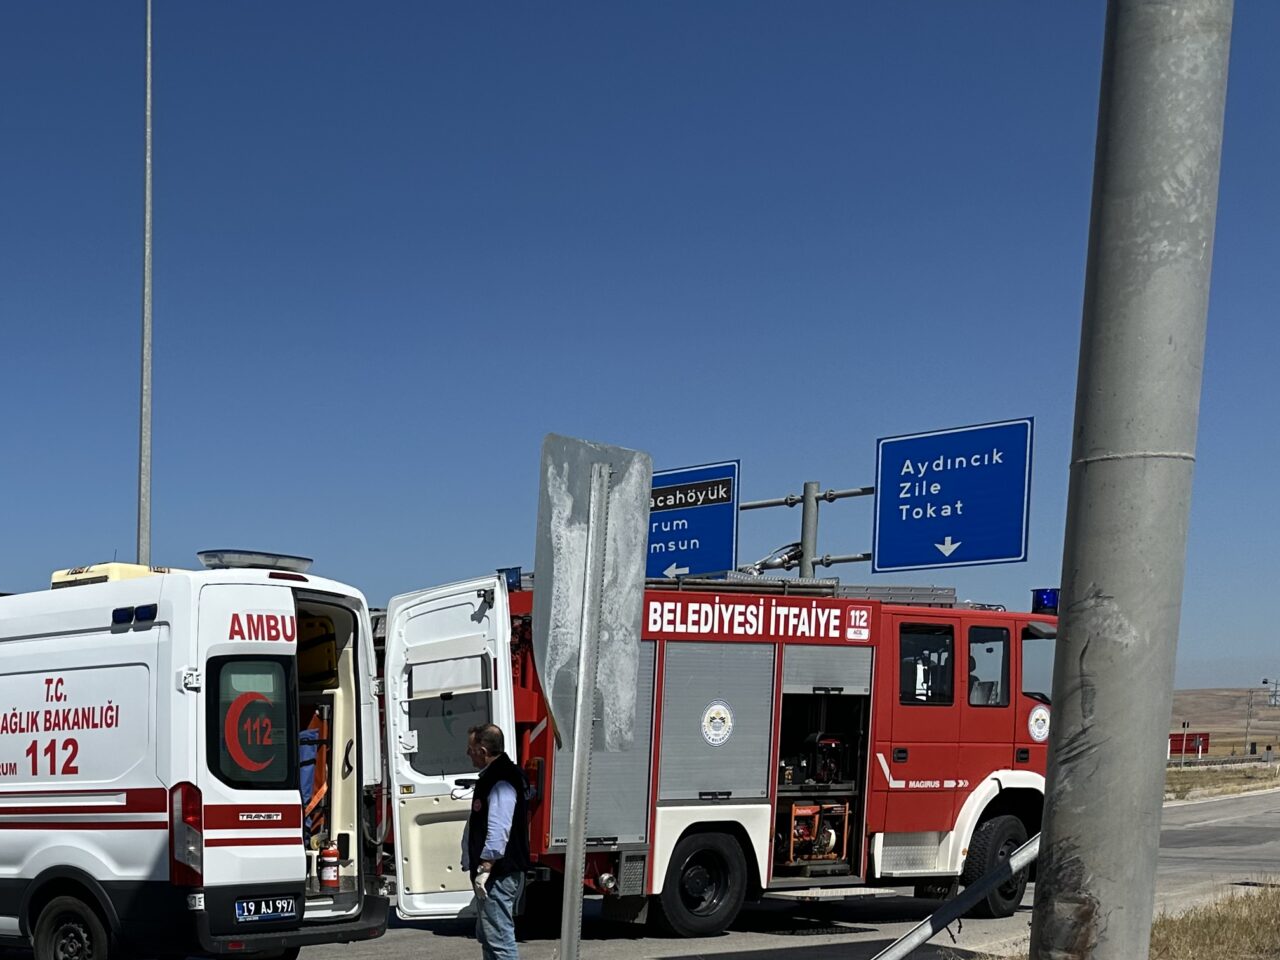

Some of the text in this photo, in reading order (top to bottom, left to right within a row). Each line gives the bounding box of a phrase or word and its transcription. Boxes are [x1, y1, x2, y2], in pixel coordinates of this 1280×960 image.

[900, 447, 1004, 478] Aydıncık
[649, 484, 728, 508] acahöyük
[899, 480, 942, 498] Zile
[899, 500, 964, 521] Tokat
[652, 518, 688, 533] rum
[650, 538, 700, 554] msun
[228, 613, 296, 642] AMBU
[647, 596, 842, 638] BELEDİYESİ İTFAİYE
[850, 609, 868, 627] 112
[44, 677, 68, 703] T.C.
[43, 700, 120, 732] BAKANLIĞI
[243, 718, 273, 745] 112
[25, 737, 79, 776] 112
[908, 780, 940, 789] MAGIRUS
[242, 899, 293, 916] 19 AJ 997
